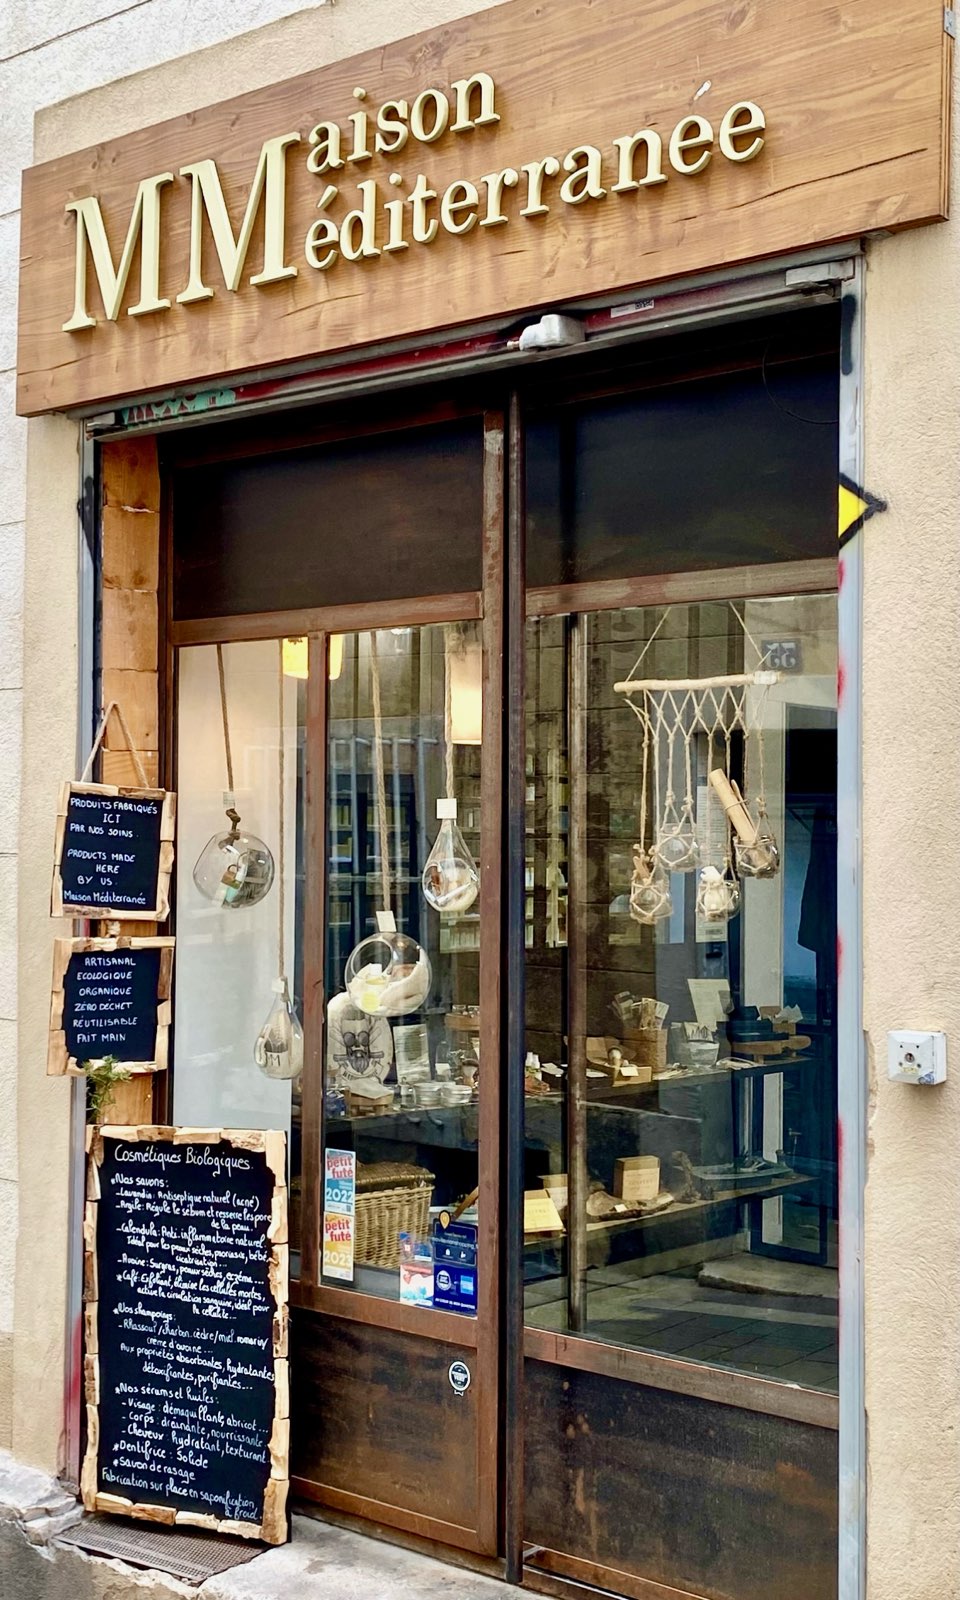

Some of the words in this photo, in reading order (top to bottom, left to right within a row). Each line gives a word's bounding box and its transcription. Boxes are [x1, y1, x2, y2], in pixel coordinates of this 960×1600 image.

[70, 797, 112, 808] PRODUITS
[113, 802, 158, 814] FABRIQUÉS
[70, 822, 86, 832] PAR
[88, 826, 104, 834] NOS
[67, 848, 107, 860] PRODUCTS
[111, 853, 136, 862] MADE
[96, 864, 120, 874] HERE
[77, 875, 93, 884] BY
[64, 890, 92, 902] Maison
[92, 891, 146, 904] Méditerranée
[84, 956, 136, 966] ARTISANAL
[76, 971, 132, 980] ECOLOGIQUE
[79, 985, 132, 996] ORGANIQUE
[74, 1000, 98, 1012] ZÉRO
[98, 998, 133, 1010] DÉCHET
[72, 1015, 138, 1028] RÉUTILISABLE
[76, 1033, 97, 1044] FAIT
[101, 1033, 126, 1042] MAIN
[114, 1143, 182, 1171] Cosmétiques
[326, 1156, 352, 1170] petit
[115, 1172, 134, 1184] Nos
[332, 1167, 354, 1178] futé
[157, 1190, 202, 1208] Antiseptique
[202, 1190, 230, 1204] naturel
[232, 1193, 260, 1212] (acné)
[326, 1187, 353, 1203] 2022
[146, 1200, 171, 1217] Régule
[172, 1202, 180, 1214] le
[182, 1204, 206, 1216] sébum
[206, 1206, 214, 1218] et
[243, 1208, 254, 1221] les
[210, 1218, 220, 1229] de
[220, 1218, 230, 1230] la
[325, 1218, 350, 1234] petit
[330, 1230, 352, 1242] futé
[146, 1242, 160, 1254] pour
[160, 1238, 170, 1250] les
[198, 1278, 210, 1292] les
[158, 1286, 166, 1298] la
[252, 1304, 270, 1316] pour
[192, 1304, 200, 1314] la
[146, 1336, 167, 1348] crème
[120, 1342, 134, 1353] Aux
[136, 1346, 174, 1360] propriétés
[120, 1382, 139, 1392] Nos
[140, 1382, 174, 1398] sérums
[174, 1386, 184, 1400] et
[176, 1450, 208, 1468] Solide
[120, 1456, 148, 1470] Savon
[149, 1460, 162, 1472] de
[164, 1466, 196, 1484] rasage
[102, 1466, 148, 1490] Fabrication
[150, 1482, 164, 1491] sur
[166, 1477, 188, 1497] place
[188, 1488, 198, 1498] en
[200, 1490, 255, 1509] saponification
[224, 1506, 232, 1518] à
